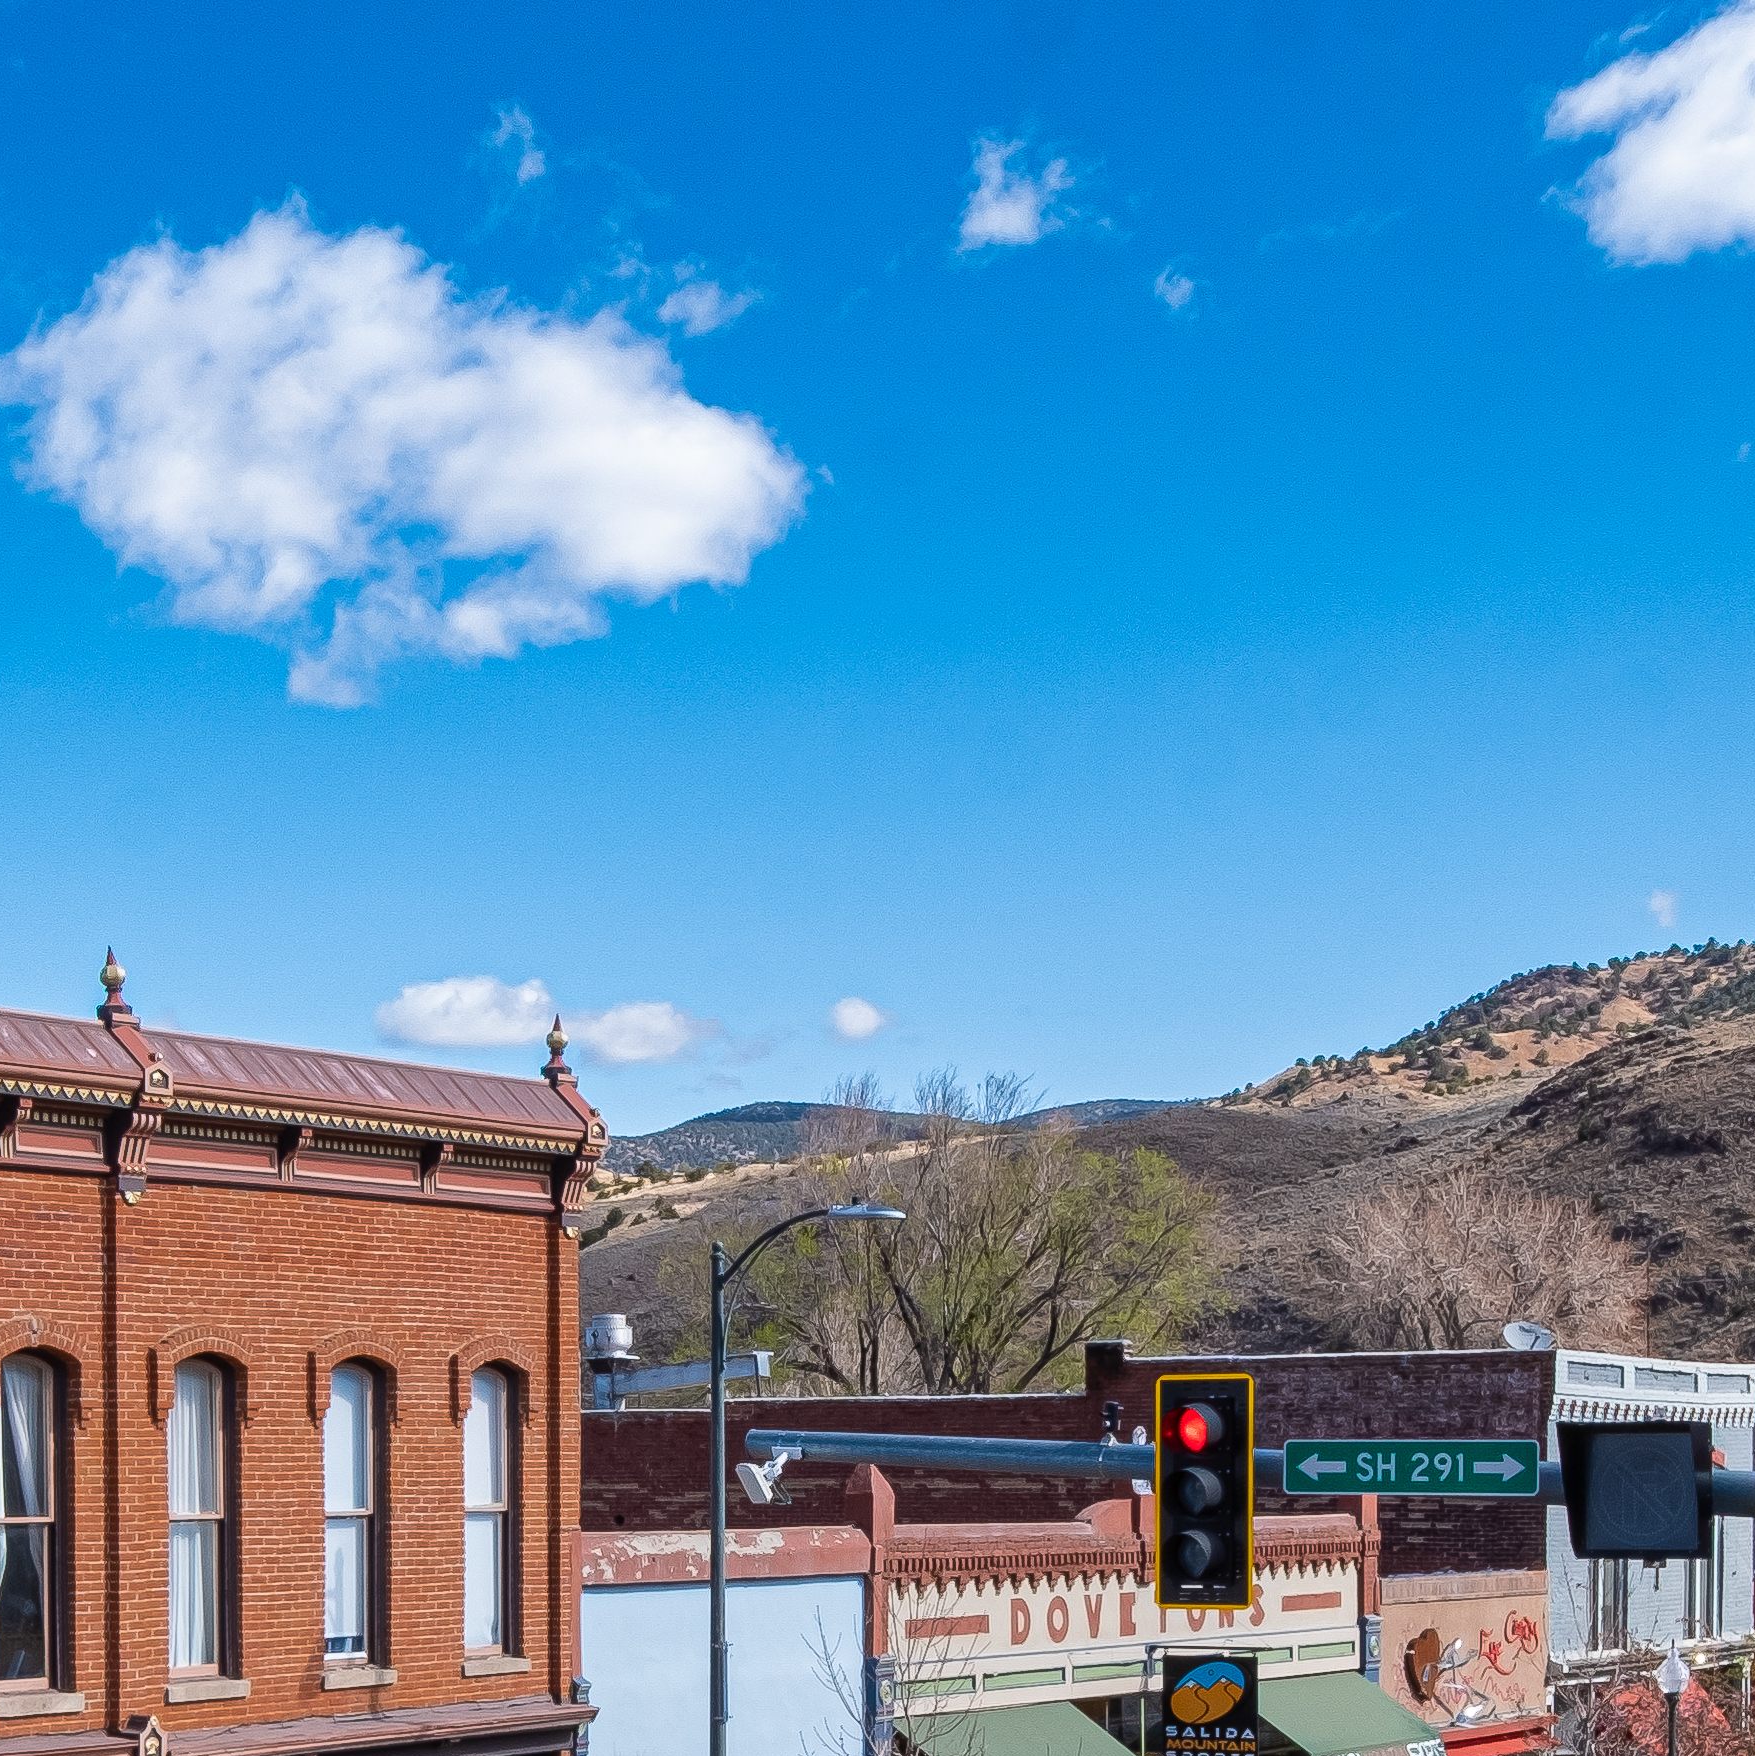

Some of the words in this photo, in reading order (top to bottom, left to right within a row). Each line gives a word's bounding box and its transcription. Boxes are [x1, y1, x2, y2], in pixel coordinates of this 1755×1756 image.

[1356, 1453, 1396, 1483] SH
[1410, 1453, 1466, 1483] 291
[1165, 1725, 1256, 1739] SALIDA
[1166, 1739, 1256, 1752] MOUNTAIN
